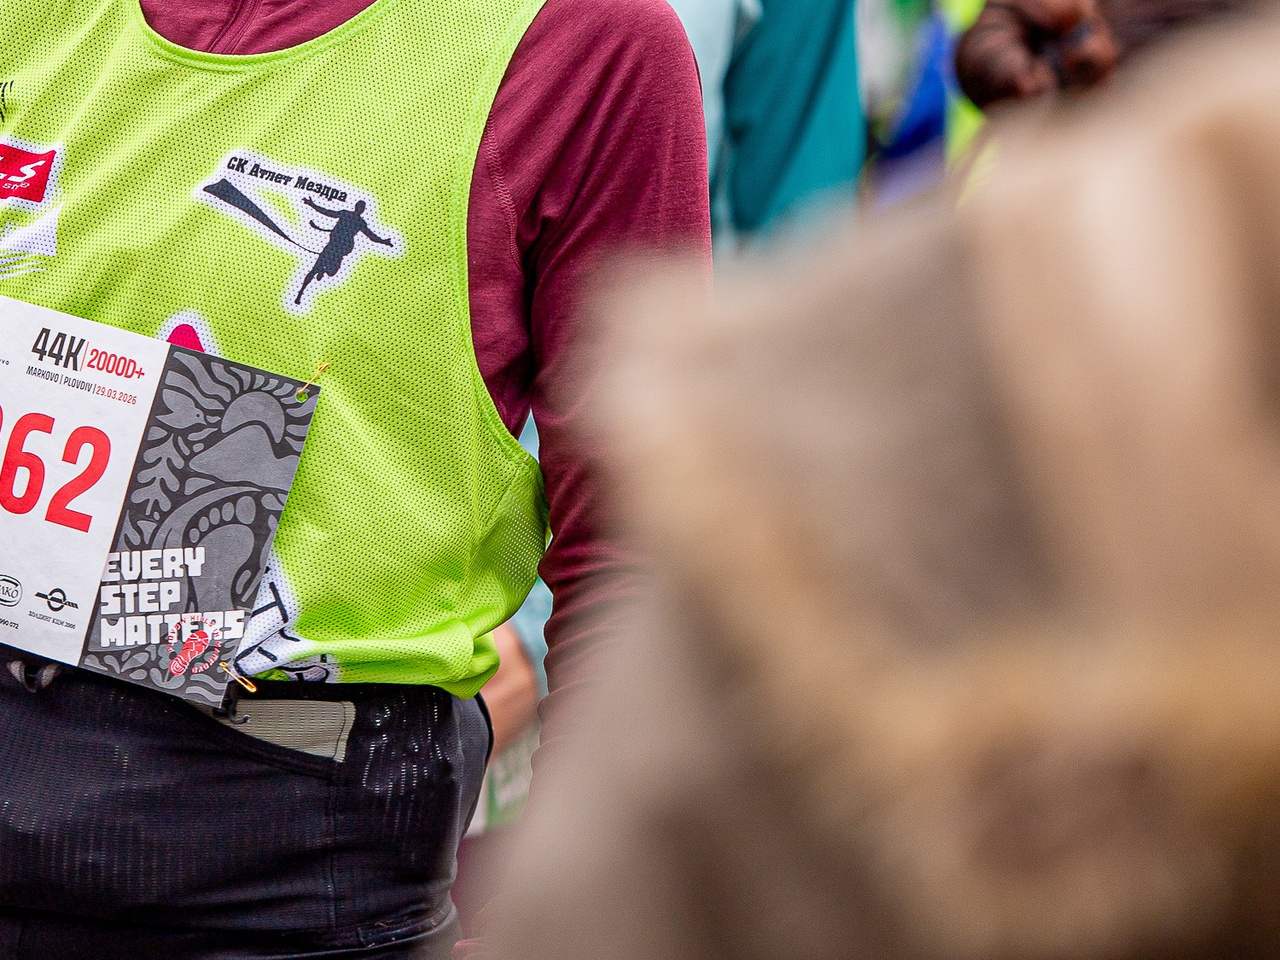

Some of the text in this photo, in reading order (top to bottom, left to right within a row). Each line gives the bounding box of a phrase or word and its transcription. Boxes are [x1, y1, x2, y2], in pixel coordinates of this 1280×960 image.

[248, 163, 294, 185] Атлет
[294, 176, 348, 202] Мездра
[31, 327, 145, 380] 44K 2000D+
[26, 366, 138, 406] MARKOVO PLOVDIV 29.03.2026
[101, 547, 205, 582] EVERY
[101, 581, 180, 615] STEP
[101, 610, 245, 647] MATTERS
